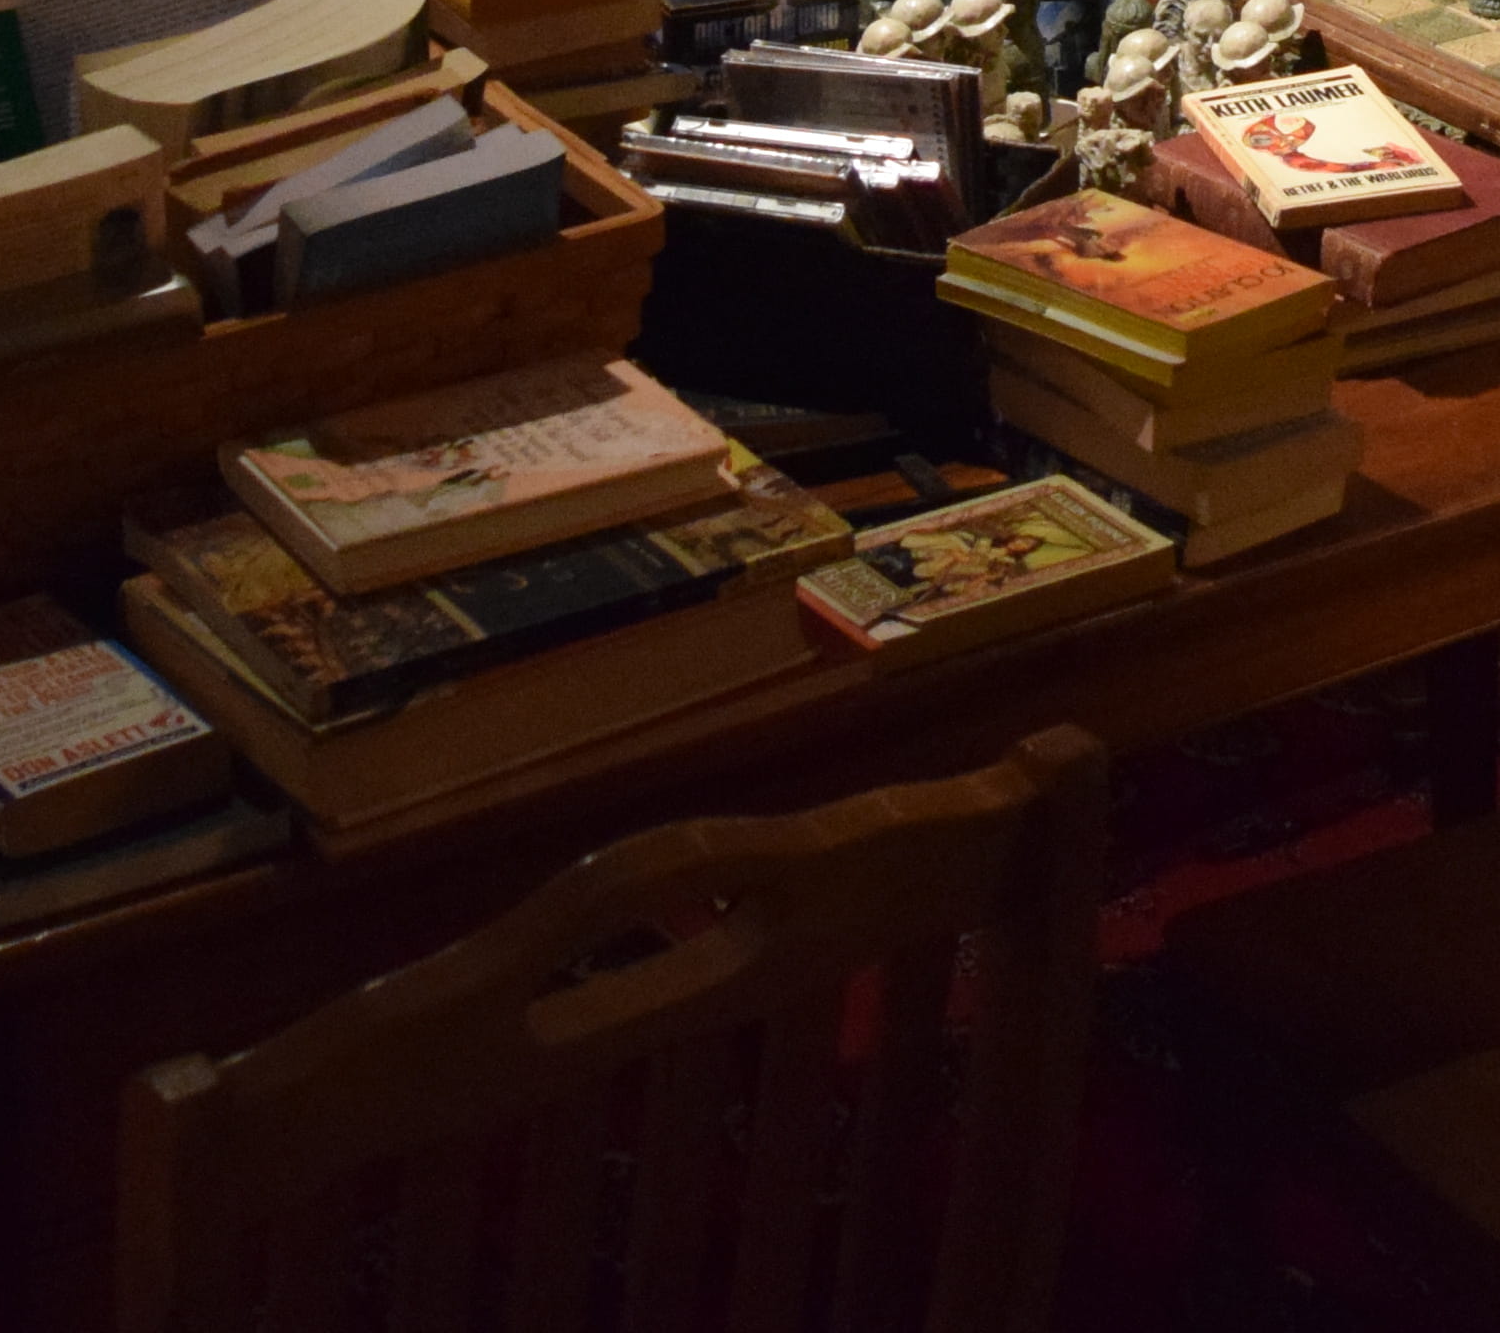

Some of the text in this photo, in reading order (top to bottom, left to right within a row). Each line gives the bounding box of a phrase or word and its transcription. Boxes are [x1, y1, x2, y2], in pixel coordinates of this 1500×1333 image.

[1209, 83, 1365, 119] KEITH LAUMER
[1338, 174, 1363, 188] THE
[1367, 166, 1440, 184] WARLORDS
[2, 724, 146, 782] DON ASLETT
